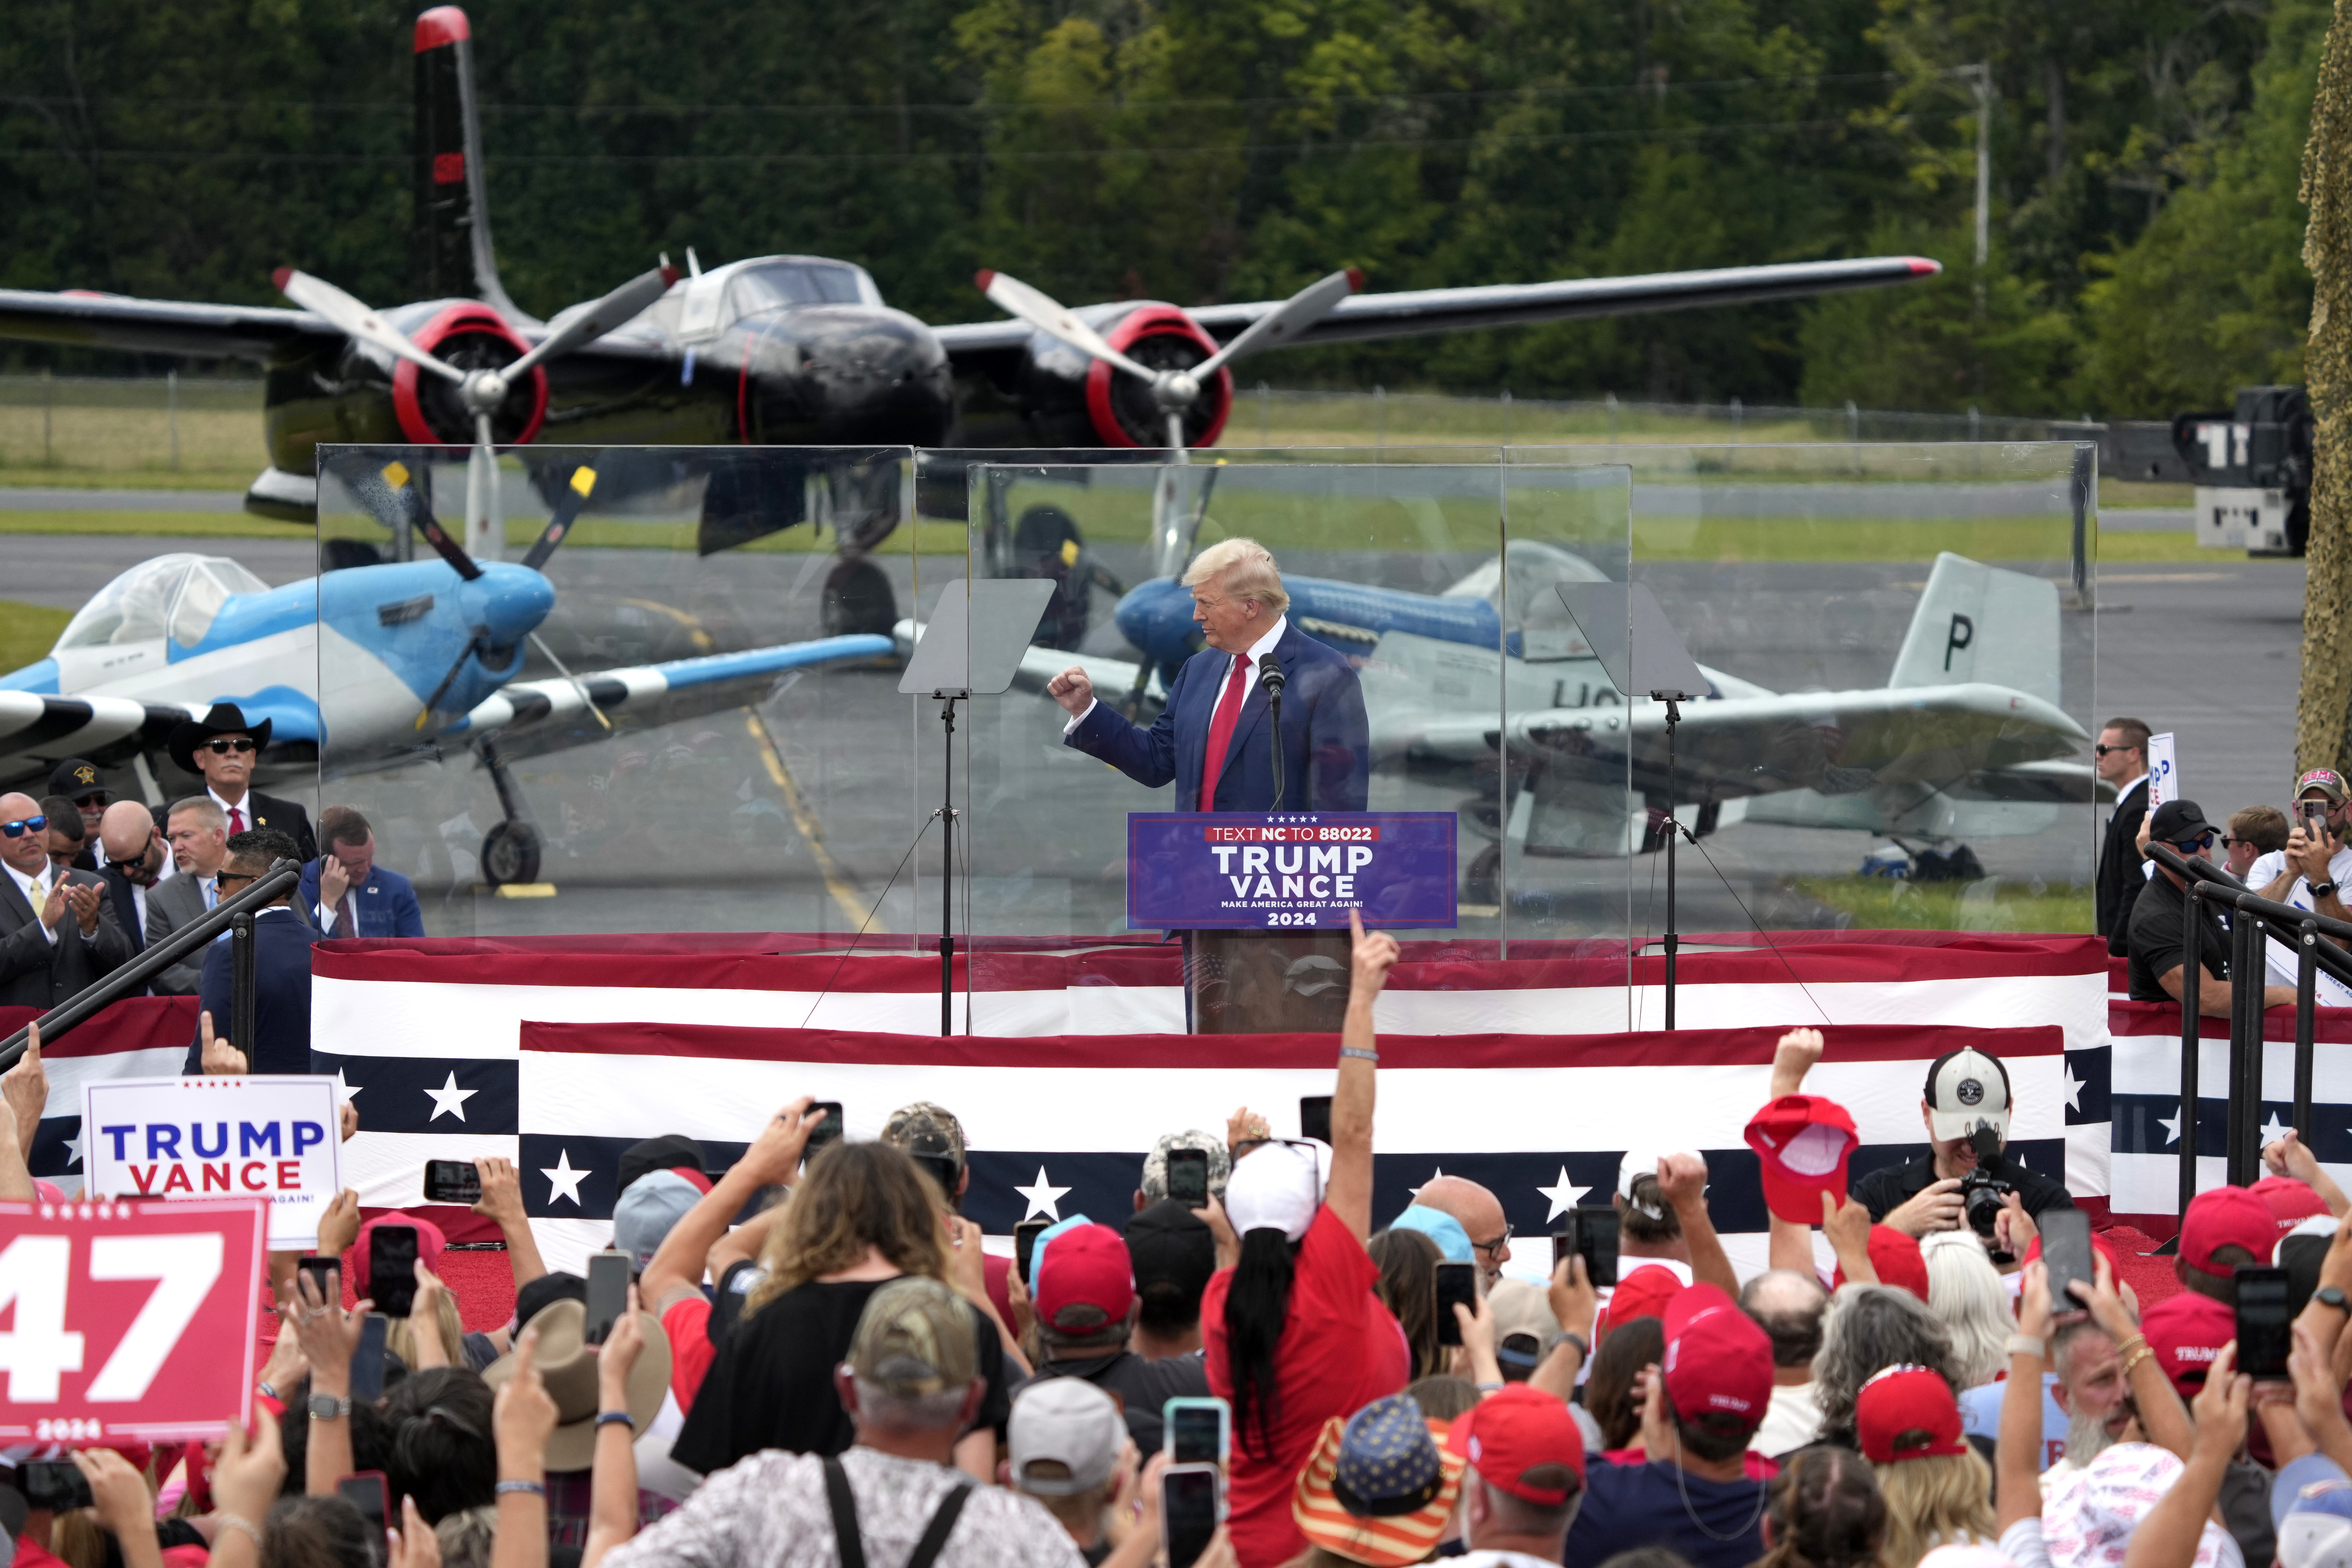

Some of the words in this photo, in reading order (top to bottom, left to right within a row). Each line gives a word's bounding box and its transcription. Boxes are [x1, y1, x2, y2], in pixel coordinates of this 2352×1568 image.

[1945, 612, 1973, 672] P
[2303, 770, 2336, 782] USMC
[1213, 828, 1256, 840] TEXT
[1261, 827, 1286, 841] NC
[1291, 827, 1314, 841] TO
[1319, 827, 1371, 841] 88022
[1212, 846, 1372, 874] TRUMP
[1230, 875, 1354, 898] VANCE
[1268, 913, 1316, 925] 2024
[2325, 974, 2344, 990] GREAT
[101, 1121, 325, 1162] TRUMP
[129, 1161, 302, 1193] VANCE
[269, 1194, 315, 1204] AGAIN!
[0, 1232, 225, 1403] 47
[35, 1418, 101, 1441] 2024
